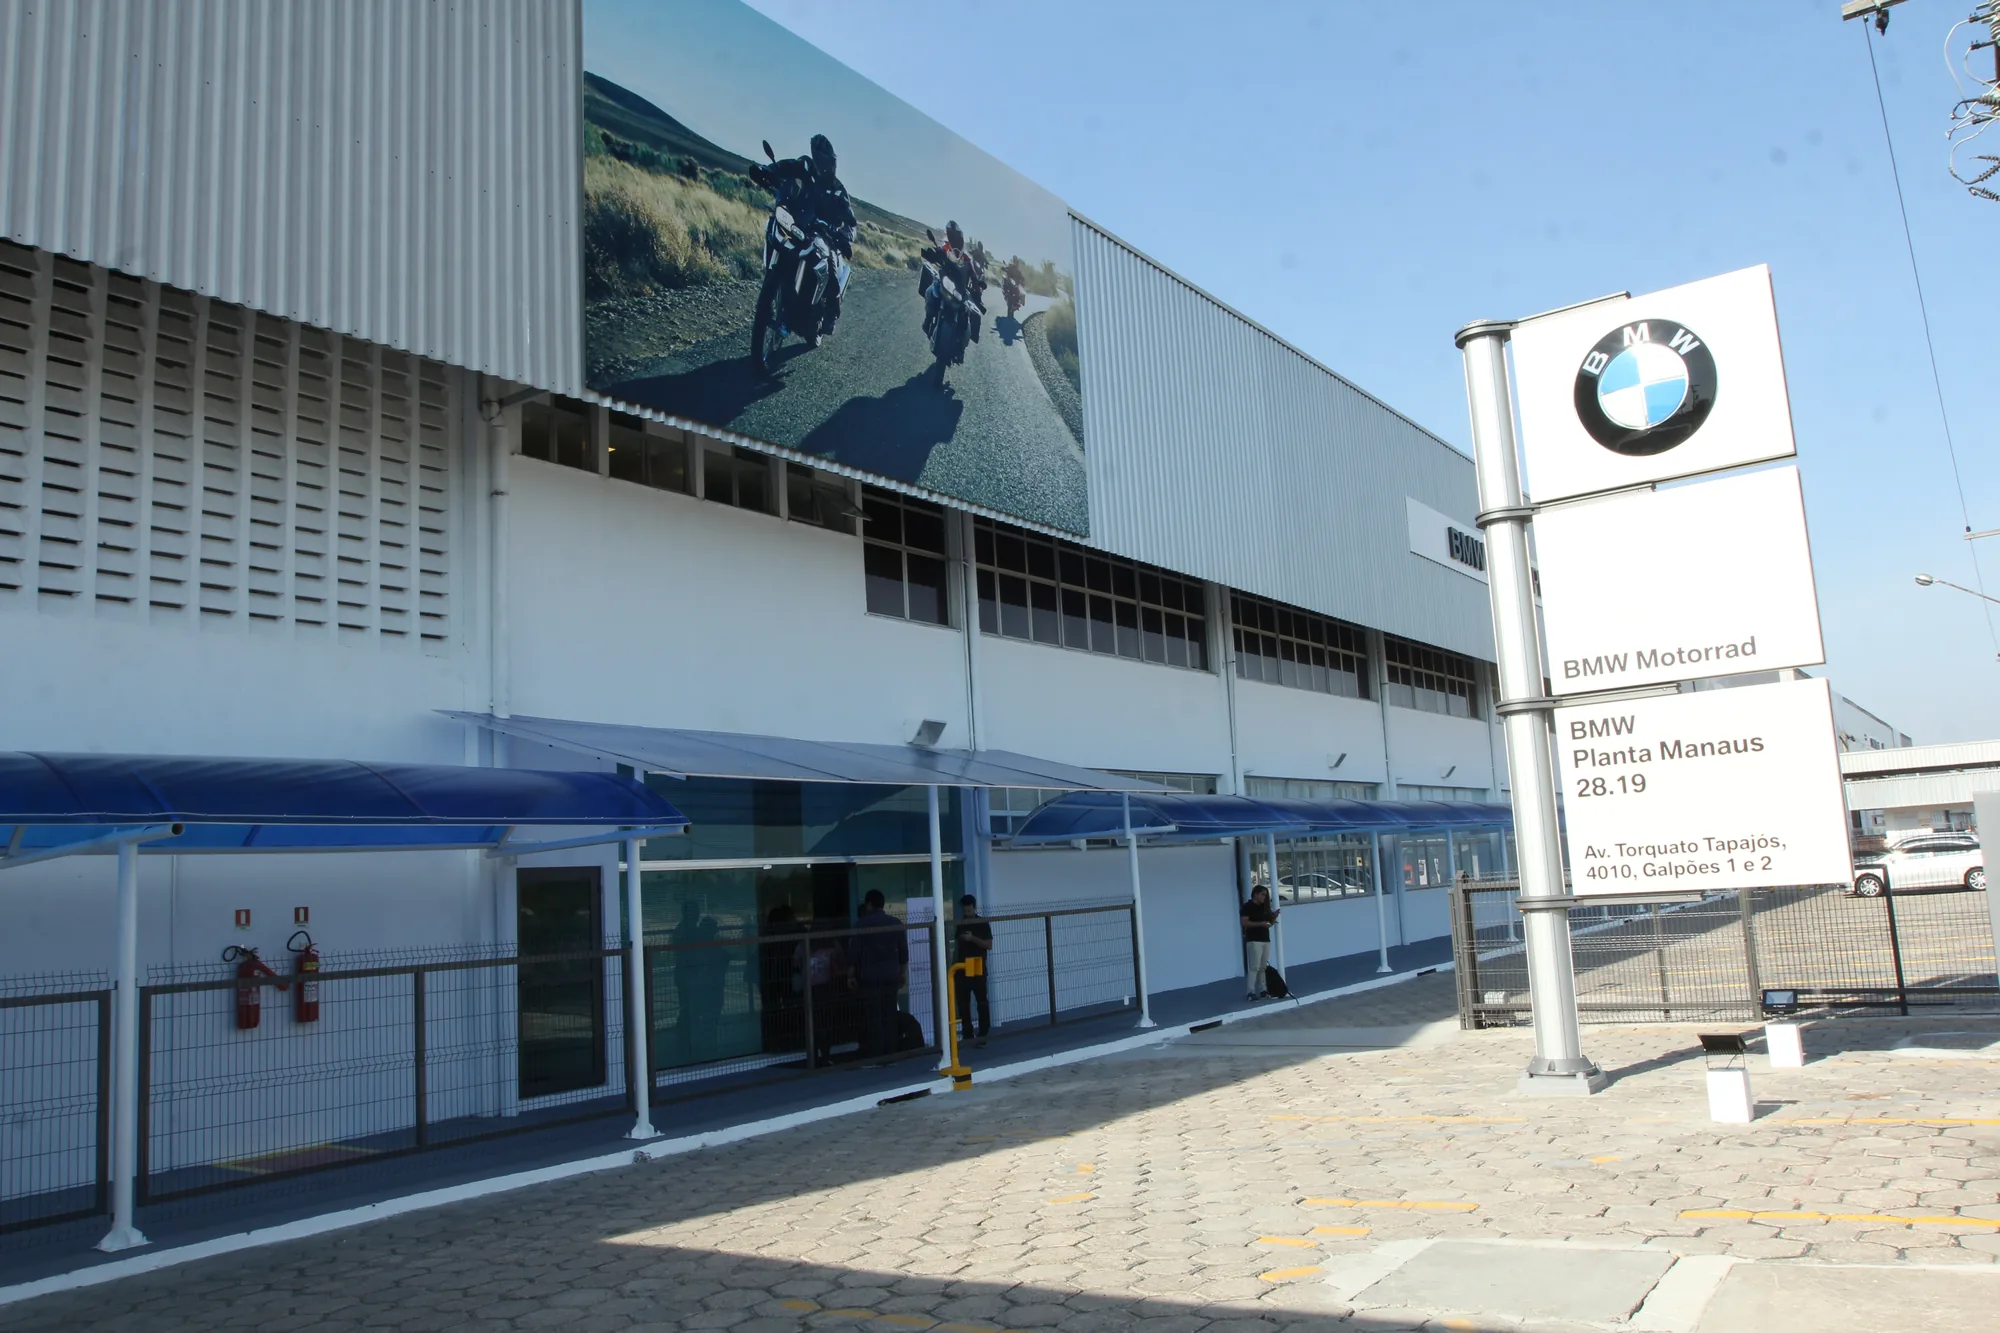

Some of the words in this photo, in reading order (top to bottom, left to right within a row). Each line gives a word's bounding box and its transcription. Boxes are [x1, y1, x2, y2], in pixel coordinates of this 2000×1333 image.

[1582, 322, 1701, 376] BMW
[1563, 652, 1628, 679] BMW
[1636, 635, 1757, 670] Motorrad
[1570, 715, 1635, 740] BMW
[1573, 746, 1652, 769] Planta
[1659, 736, 1765, 760] Manaus
[1576, 773, 1647, 798] 28.19
[1584, 845, 1611, 859] Av.
[1615, 840, 1699, 858] Torquato
[1702, 833, 1787, 854] Tapajós,
[1586, 864, 1638, 881] 4010,
[1642, 859, 1721, 878] Galpões
[1727, 858, 1736, 873] 1
[1743, 860, 1755, 871] e
[1760, 855, 1773, 871] 2
